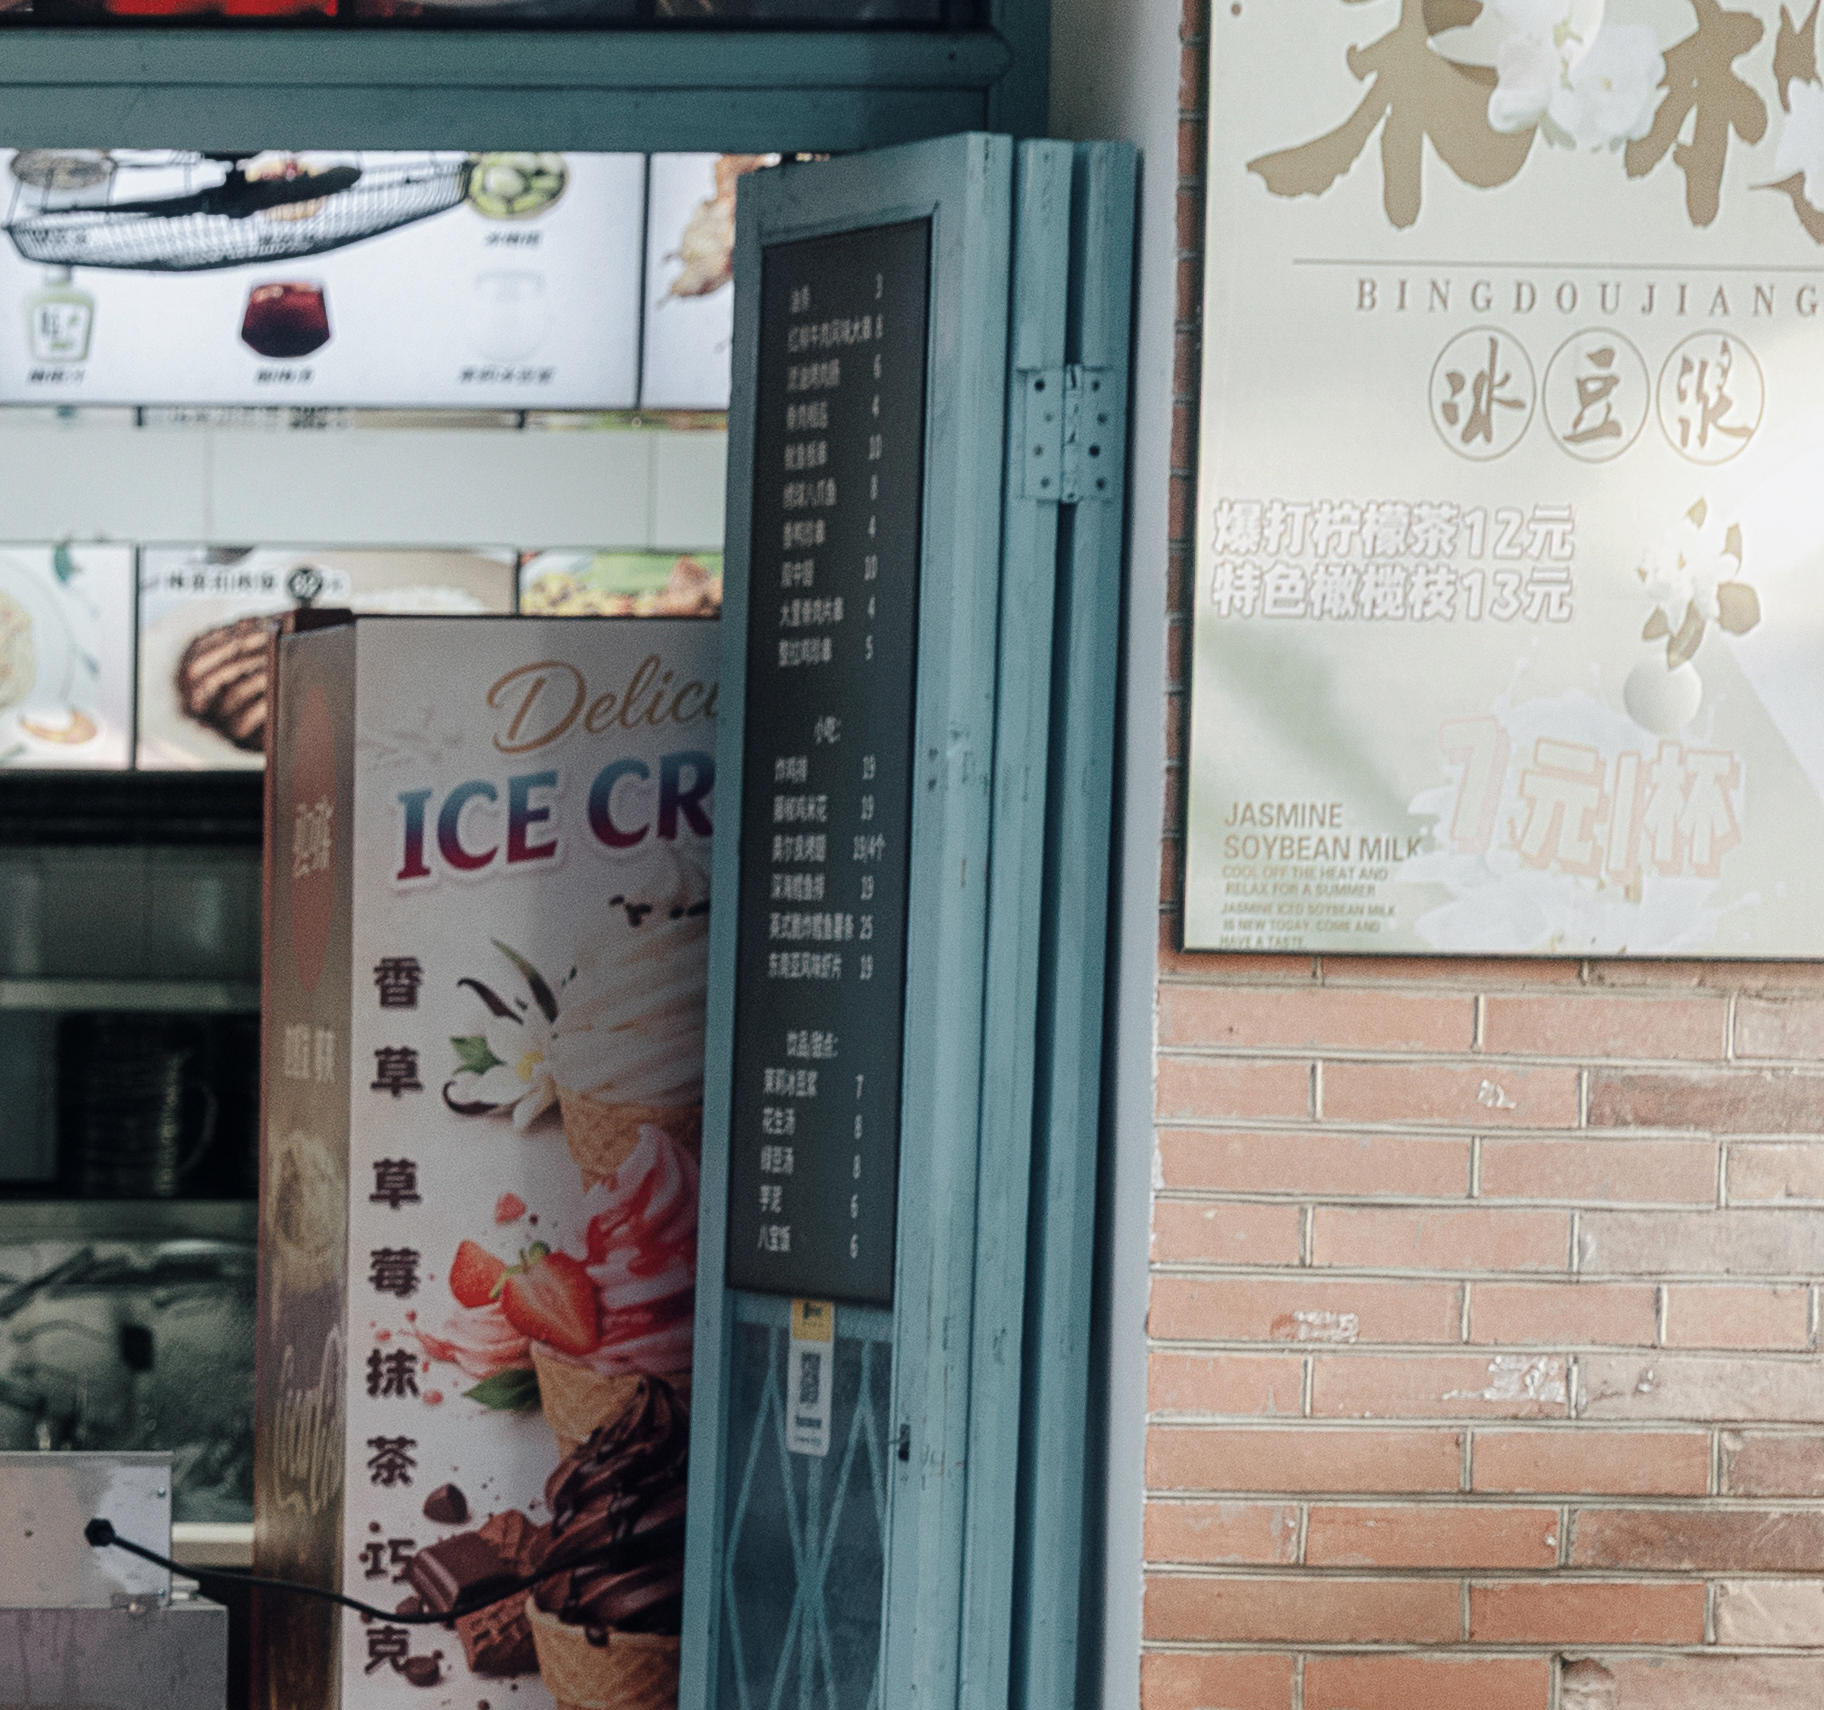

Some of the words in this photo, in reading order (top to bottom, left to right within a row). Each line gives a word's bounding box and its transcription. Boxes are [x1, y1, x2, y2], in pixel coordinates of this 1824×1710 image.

[1356, 278, 1820, 318] BINGDOUJIANG
[1441, 336, 1753, 450] 冰豆浆
[1213, 499, 1576, 559] 爆打柠檬茶12元
[1211, 562, 1575, 623] 特色橄榄枝13元
[396, 770, 559, 882] ICE
[1224, 802, 1343, 828] JASMINE
[1221, 865, 1257, 880] COOL
[1262, 865, 1288, 880] OFF
[1292, 865, 1316, 880] THE
[1319, 866, 1353, 880] HEAT
[1358, 866, 1389, 881] AND
[1223, 834, 1351, 861] SOYBEAN
[1358, 836, 1423, 862] MILK
[1225, 883, 1267, 897] RELAX
[1272, 883, 1298, 897] FOR
[1303, 884, 1312, 897] A
[1315, 884, 1377, 898] SUMMER
[1238, 919, 1265, 932] NEW
[1355, 920, 1381, 934] AND
[370, 957, 424, 1098] 香草
[368, 1157, 422, 1298] 草莓
[365, 1347, 419, 1488] 抹茶
